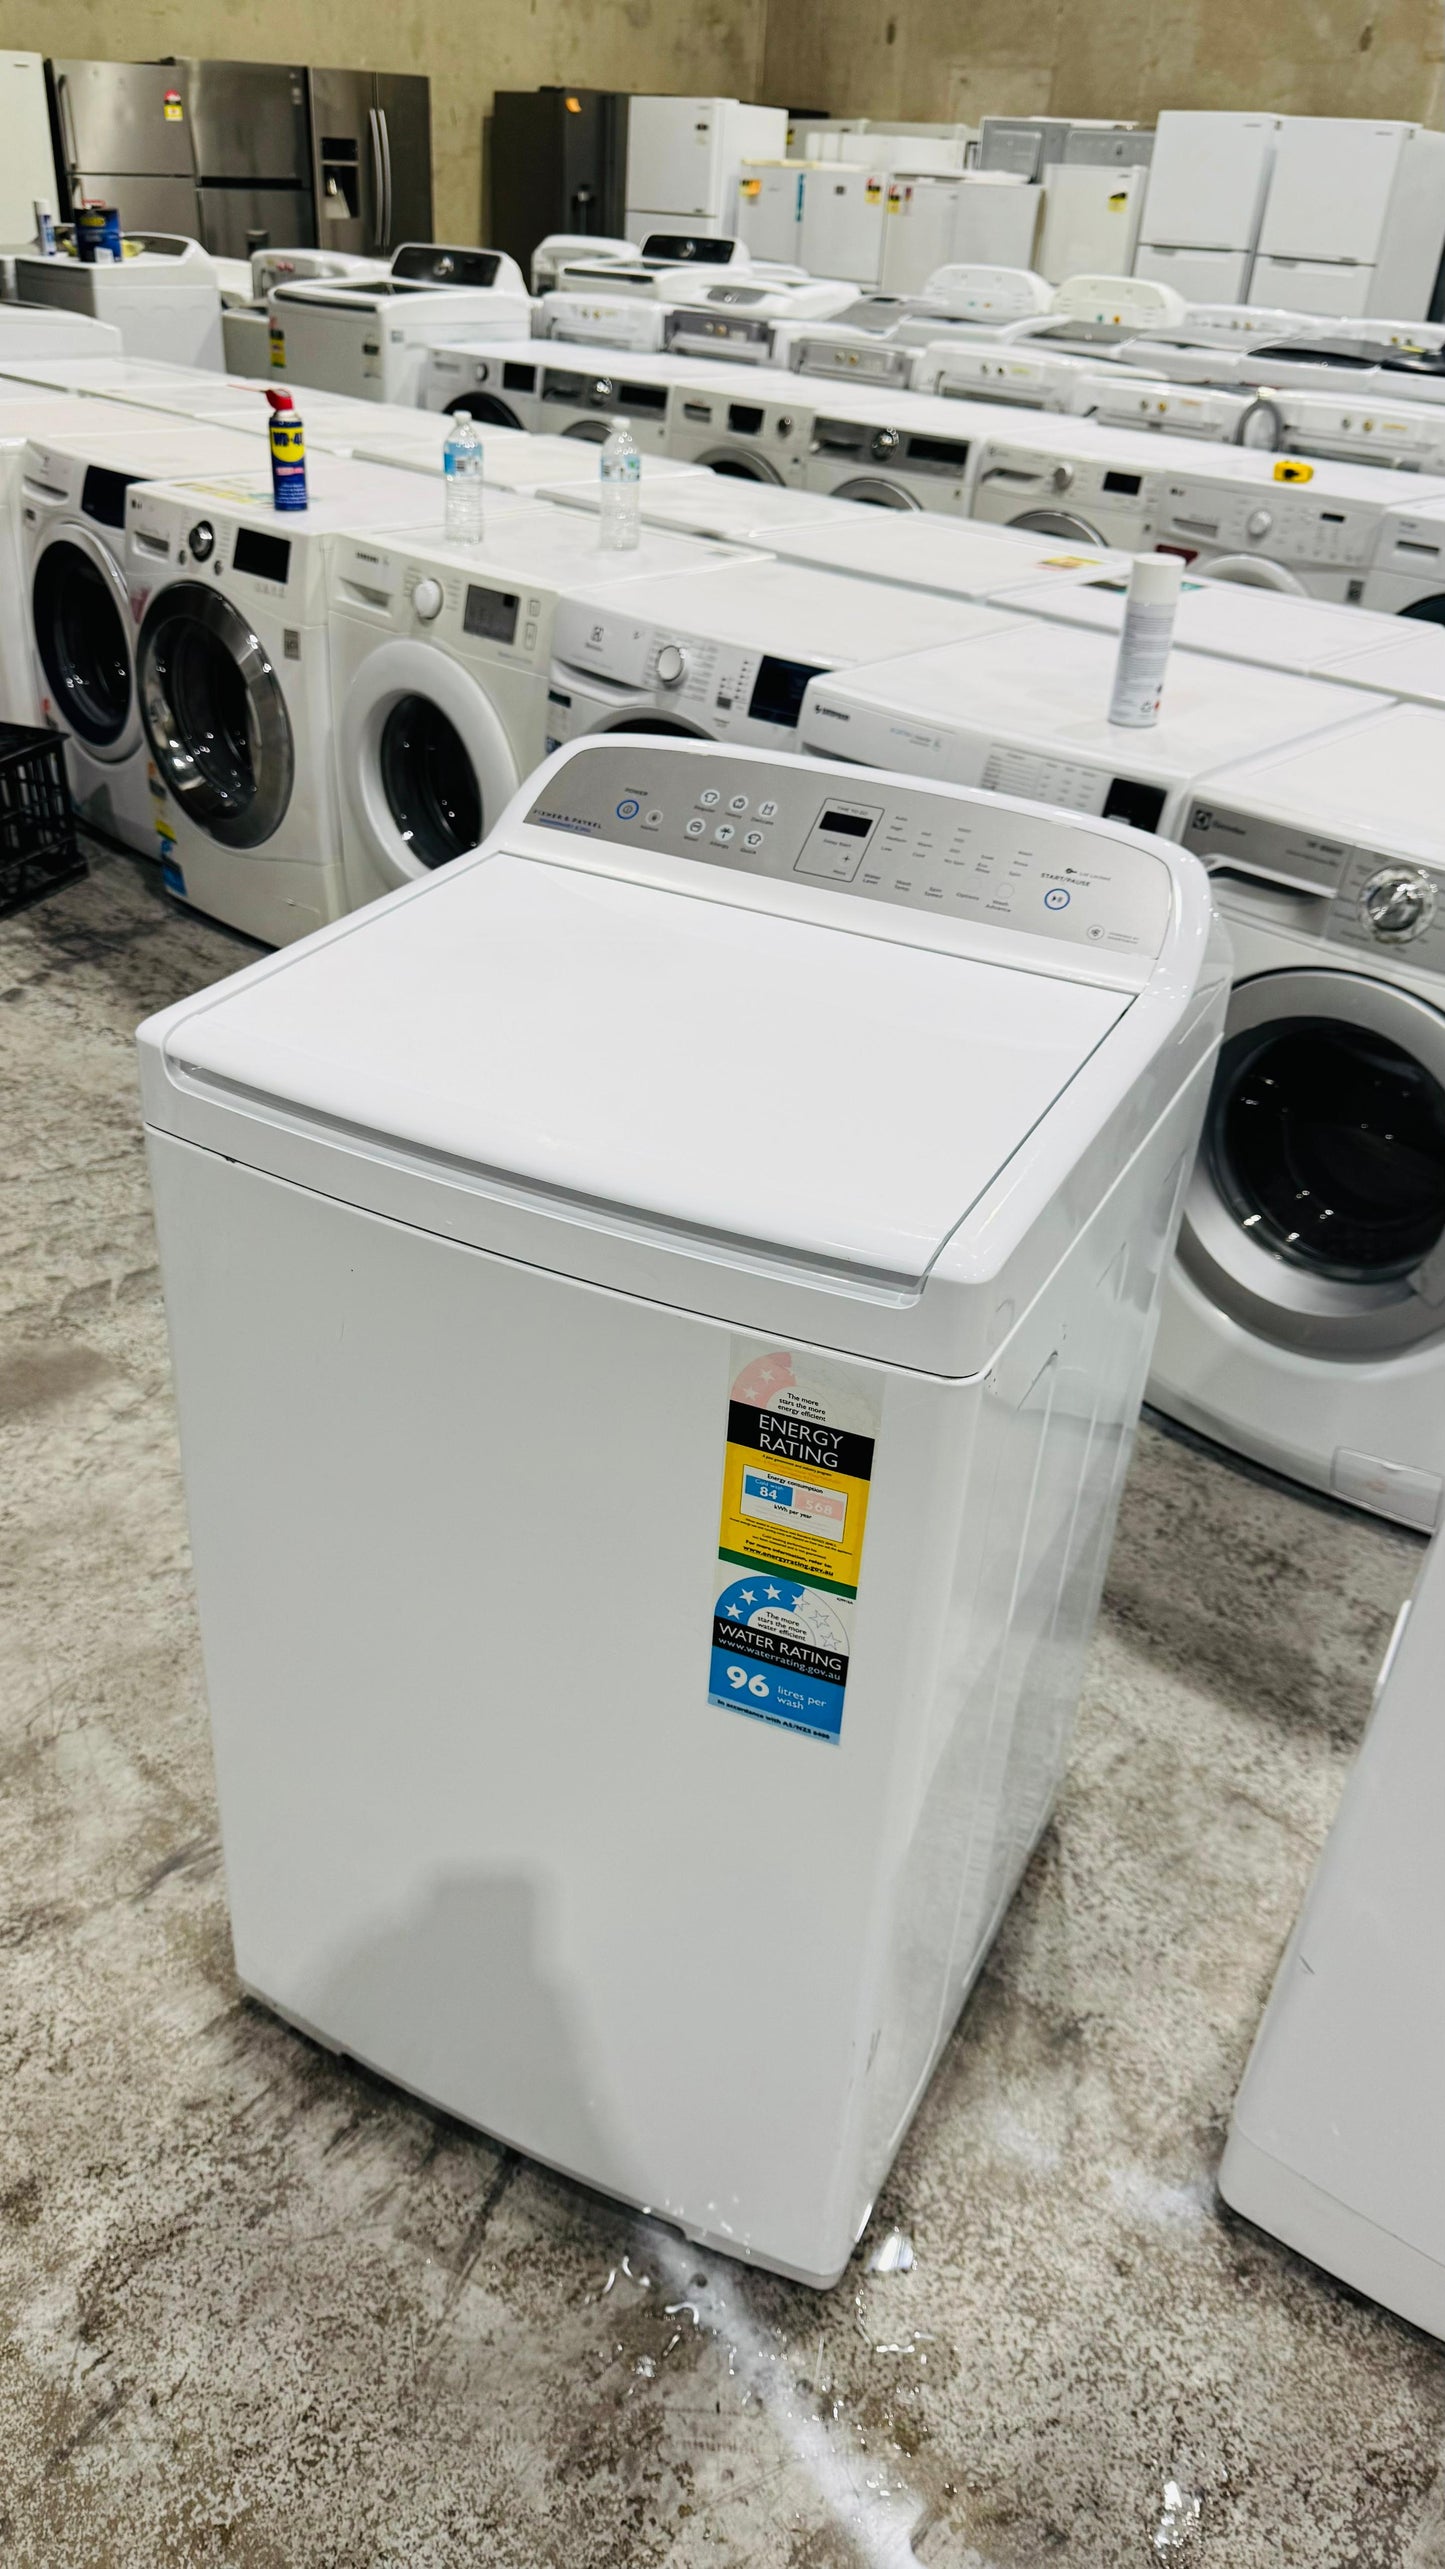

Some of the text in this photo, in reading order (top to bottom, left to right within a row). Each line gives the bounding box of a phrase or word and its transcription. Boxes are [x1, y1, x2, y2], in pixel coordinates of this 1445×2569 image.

[779, 1398, 826, 1415] stars the more
[787, 1392, 819, 1406] The more
[778, 1405, 826, 1422] energy efficient
[759, 1413, 844, 1449] ENERGY
[760, 1433, 839, 1468] RATING
[760, 1486, 777, 1500] 84
[767, 1473, 823, 1494] Energy consumption
[774, 1504, 788, 1512] kWh
[800, 1511, 812, 1519] year
[805, 1499, 833, 1515] 568
[743, 1546, 834, 1577] www.energyrating.gov.au
[756, 1543, 772, 1551] more
[808, 1558, 822, 1566] refer
[757, 1616, 807, 1635] stars the more
[766, 1611, 800, 1627] The more
[757, 1622, 806, 1642] water efficient
[719, 1622, 842, 1671] WATER RATING
[718, 1637, 841, 1681] www.waterrating.gov.au
[726, 1665, 770, 1698] 96
[776, 1696, 804, 1710] wash
[777, 1685, 826, 1707] litres per
[726, 1702, 764, 1719] accordance
[765, 1714, 781, 1724] with
